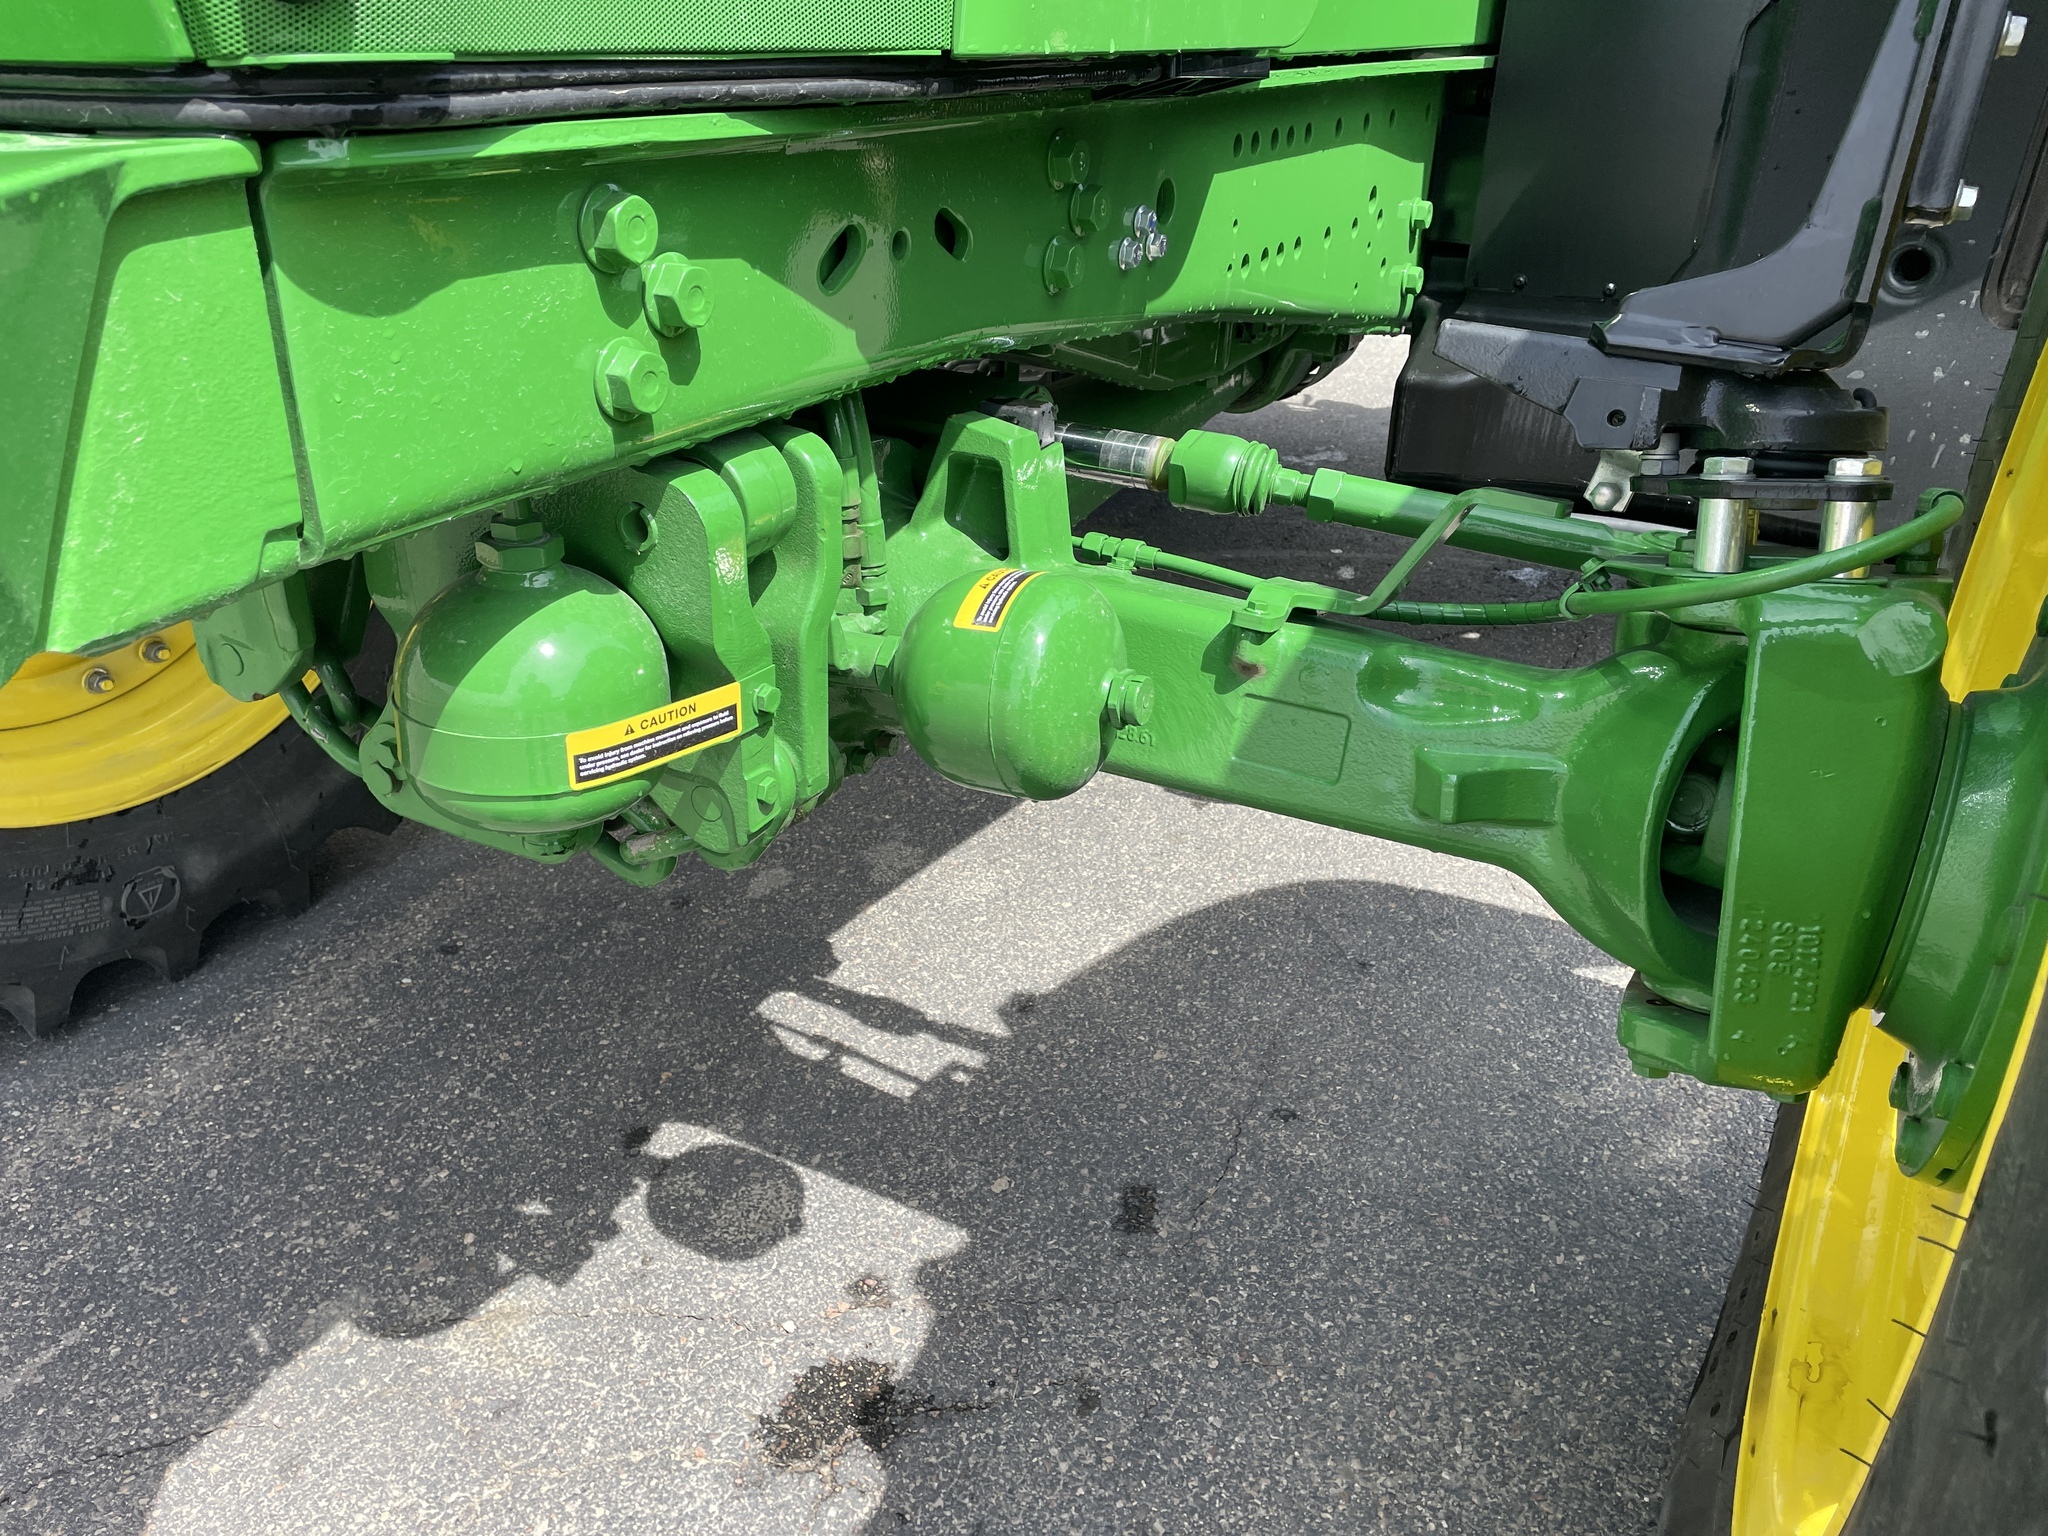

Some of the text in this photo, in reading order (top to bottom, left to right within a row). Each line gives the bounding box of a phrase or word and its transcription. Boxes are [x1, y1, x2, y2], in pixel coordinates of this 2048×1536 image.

[640, 702, 696, 730] CAUTION
[587, 752, 604, 762] avoid
[604, 748, 620, 758] injury
[1733, 918, 1765, 1004] 240423
[1767, 921, 1796, 976] S005
